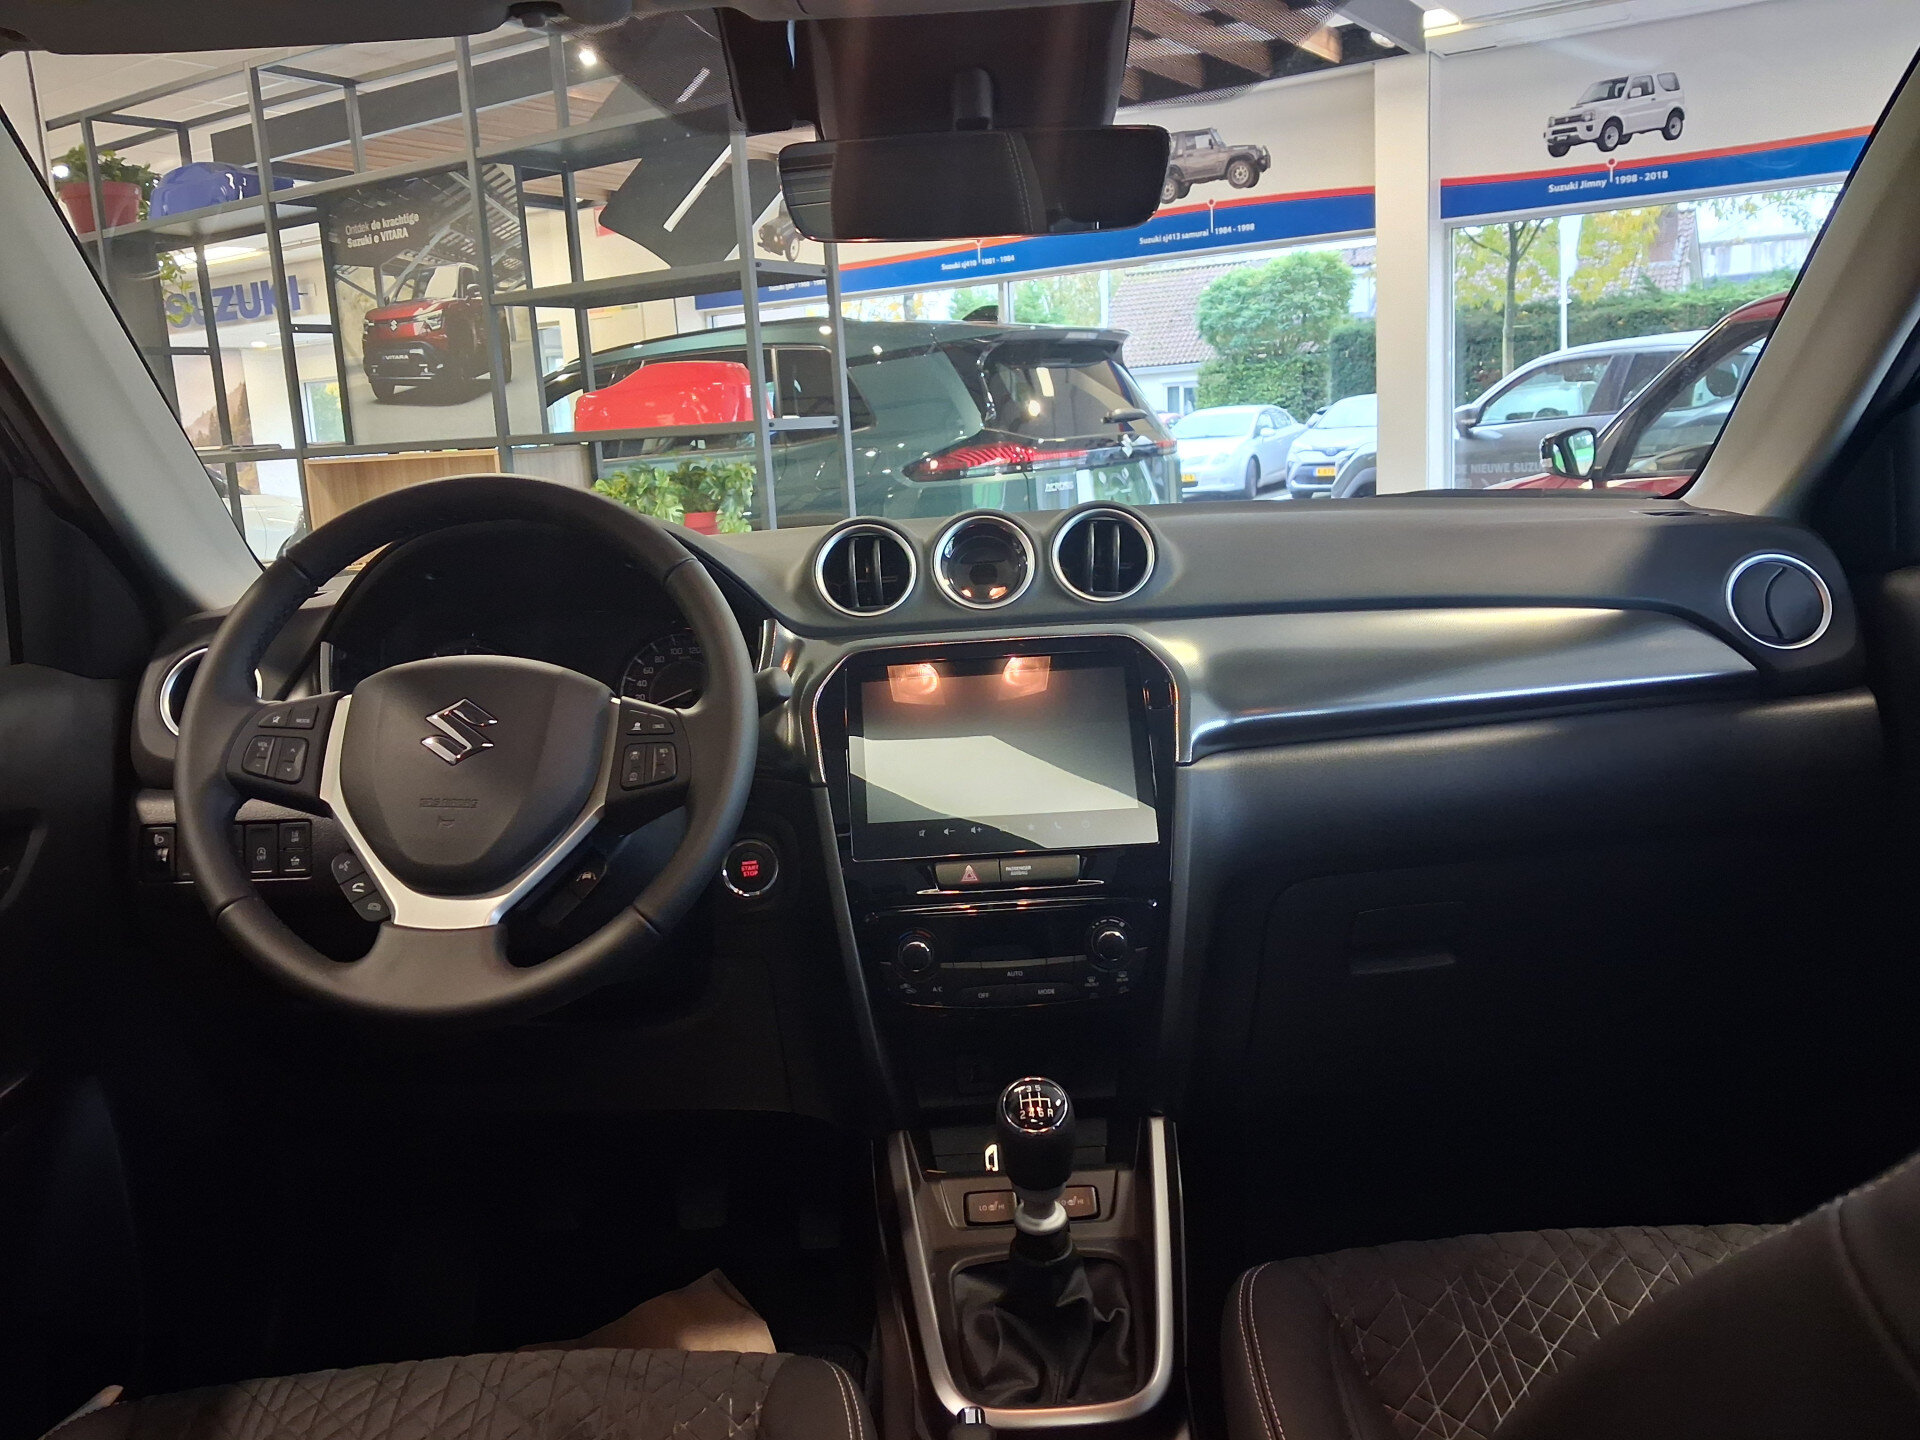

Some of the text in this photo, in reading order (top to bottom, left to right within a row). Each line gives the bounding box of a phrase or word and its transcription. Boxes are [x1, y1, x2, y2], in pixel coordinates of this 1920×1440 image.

[1548, 181, 1578, 193] Suzuki
[1579, 179, 1607, 189] Jimny
[1615, 174, 1638, 184] 1998
[1644, 170, 1668, 181] 2018
[345, 213, 419, 235] Ontdek de krachtige
[347, 227, 409, 248] Suzuki e VITARA
[1139, 235, 1162, 245] Suzuki
[1163, 232, 1180, 243] sj413
[1181, 229, 1209, 239] samurai
[941, 262, 961, 270] Suzuki
[165, 275, 301, 328] SUZUKI
[1470, 462, 1510, 474] NIEUWE
[1513, 460, 1544, 473] SUZU
[670, 646, 701, 655] 100 120
[654, 655, 665, 663] 80
[643, 666, 654, 674] 60
[636, 679, 647, 687] 40
[1035, 1084, 1041, 1092] 5
[1020, 1107, 1054, 1119] 2 4 6 R
